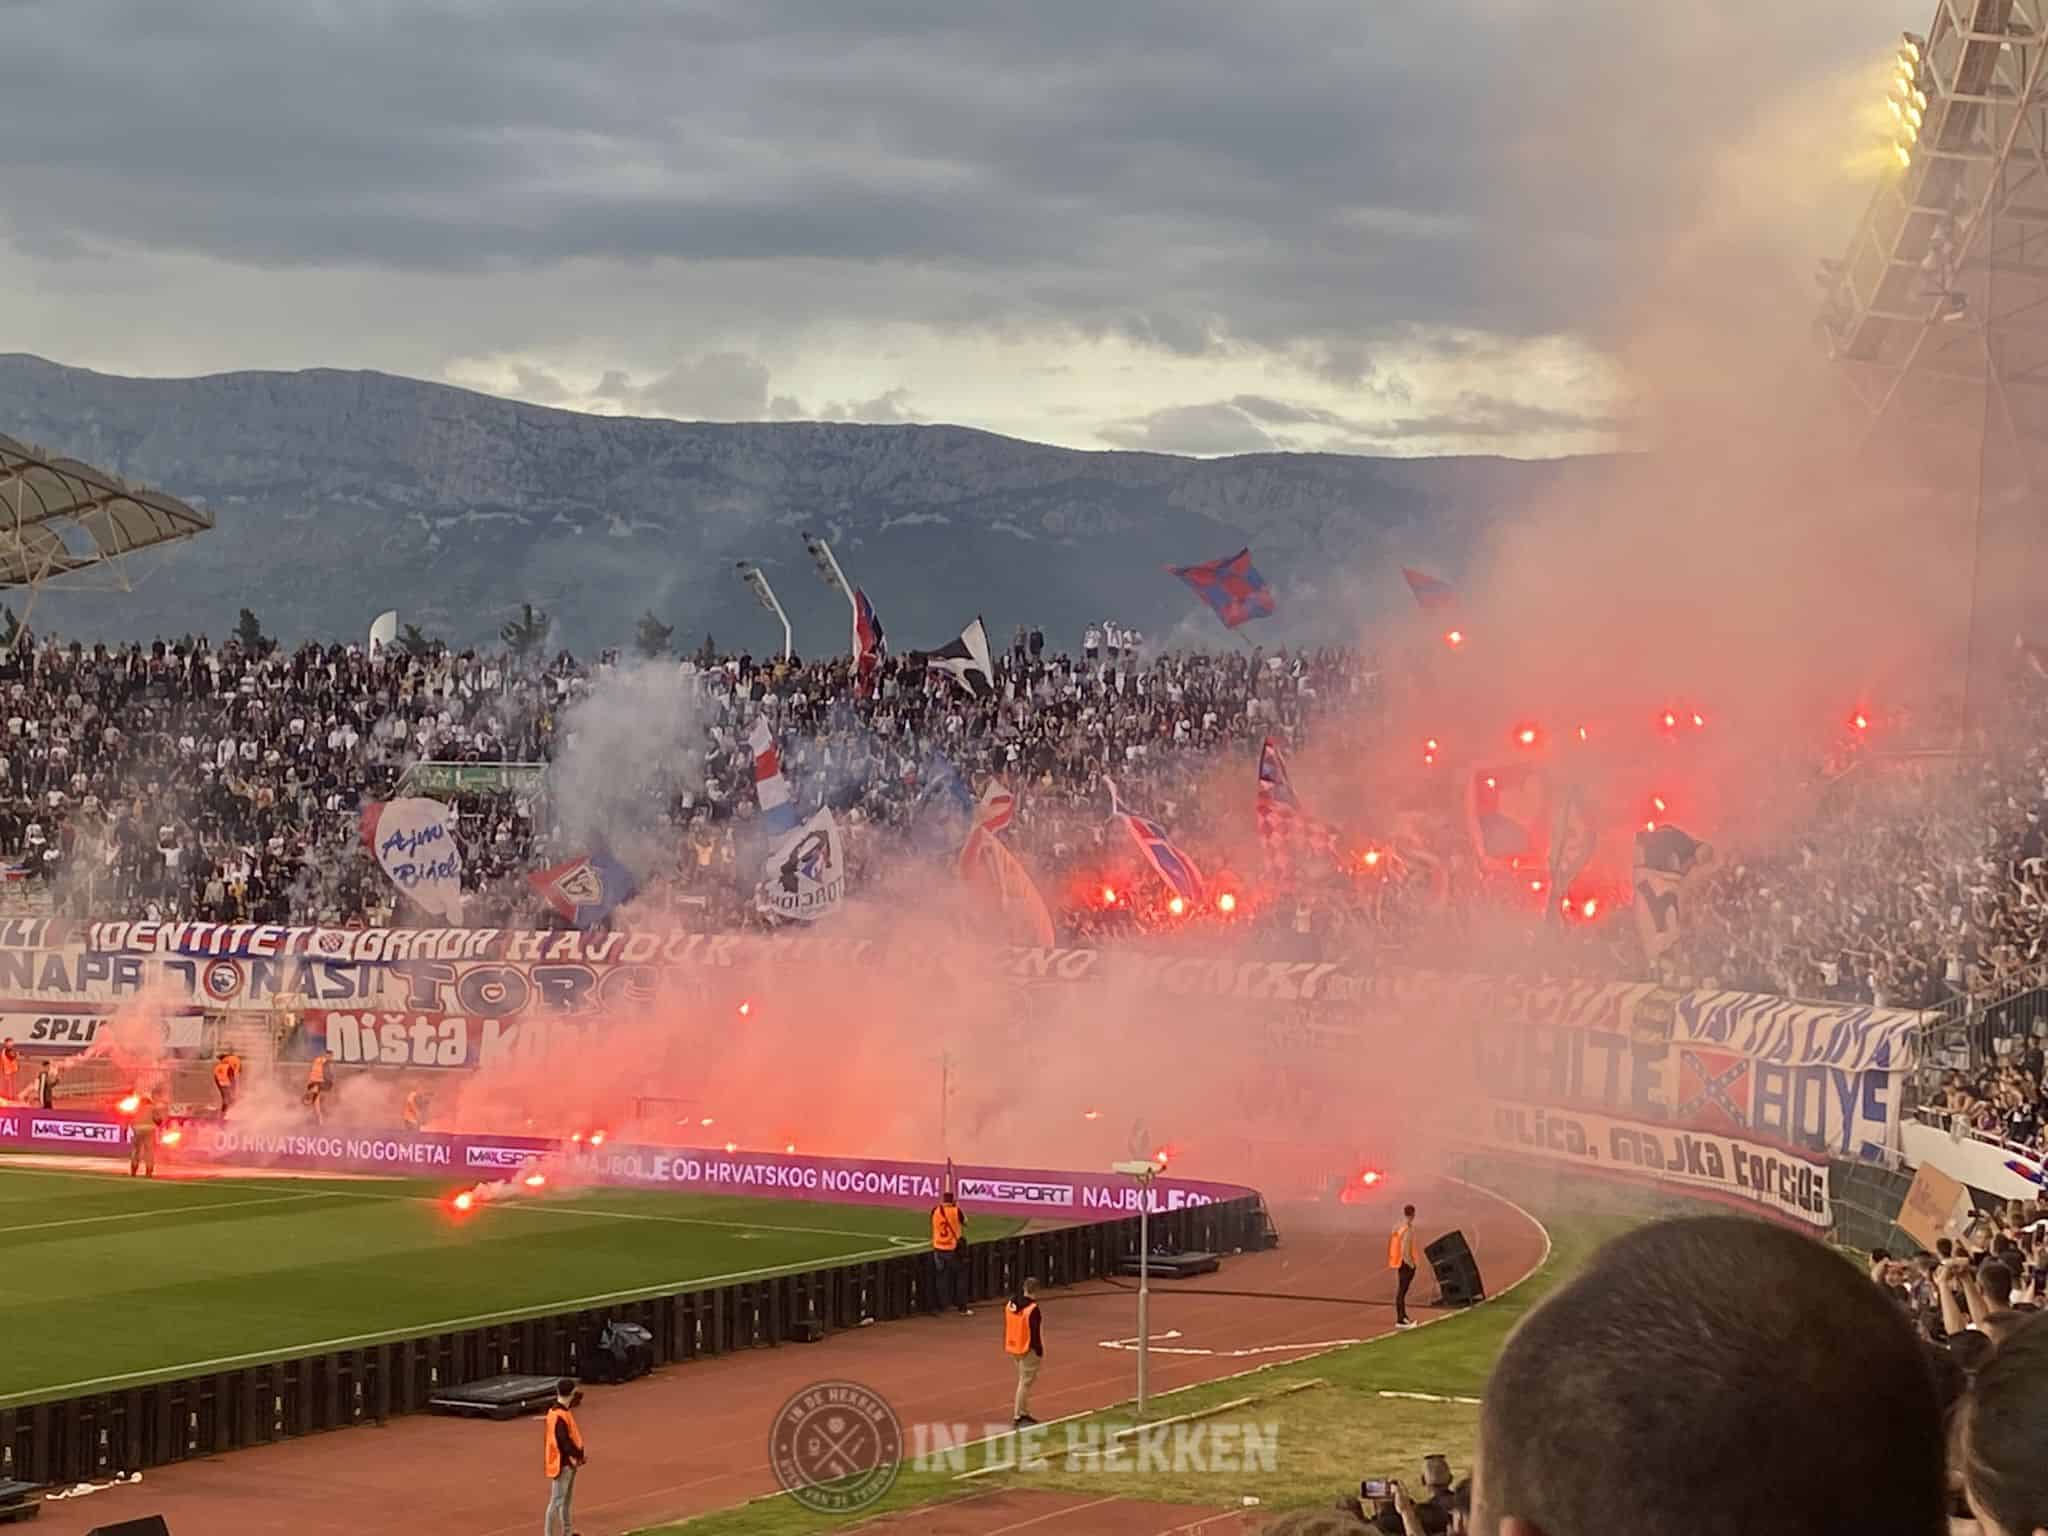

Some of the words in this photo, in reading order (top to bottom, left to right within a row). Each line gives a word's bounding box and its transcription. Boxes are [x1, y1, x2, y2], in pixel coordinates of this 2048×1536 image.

[89, 921, 312, 957] IDENTITET
[355, 928, 498, 961] GRADA
[326, 1011, 467, 1066] Ništa
[1753, 1058, 1890, 1160] BOYS
[34, 1121, 118, 1140] MAXSPORT
[243, 1135, 342, 1158] HRVATSKOG
[347, 1140, 451, 1165] NOGOMETA!
[672, 1158, 701, 1182] OD
[705, 1163, 816, 1188] HRVATSKOG
[822, 1169, 939, 1197] NOGOMETA!
[960, 1182, 1070, 1205] MAXSPORT
